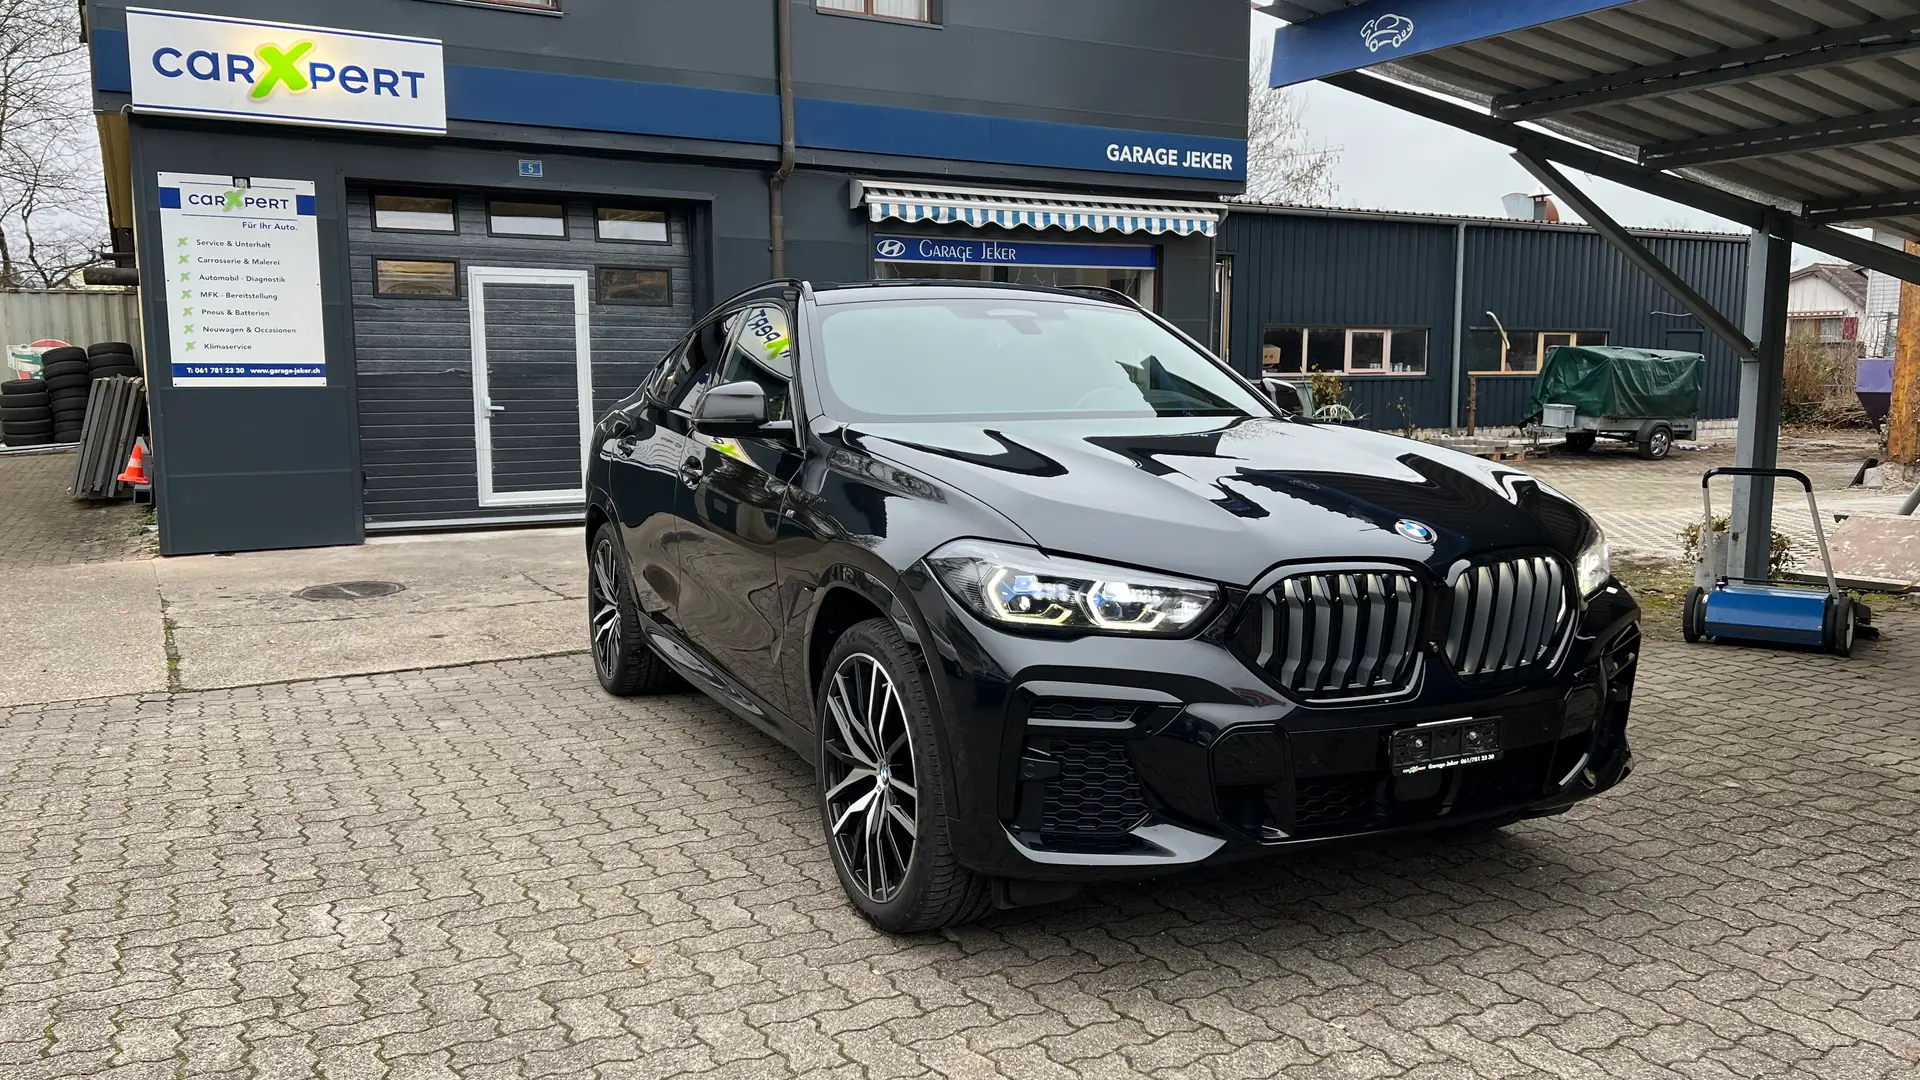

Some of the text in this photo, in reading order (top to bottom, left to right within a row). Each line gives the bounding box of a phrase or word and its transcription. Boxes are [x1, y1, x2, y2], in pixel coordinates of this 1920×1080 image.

[1106, 144, 1233, 171] GARAGE JEKER
[528, 163, 534, 173] 5
[242, 221, 298, 231] Für Ihr Auto.
[196, 239, 224, 247] Service
[235, 240, 271, 249] Unterhalt
[197, 256, 241, 265] Carrosserie
[252, 258, 280, 266] Malerei
[199, 274, 239, 282] Automobil
[246, 275, 286, 283] Diagnostik
[225, 292, 278, 301] Bereitstellung
[201, 308, 225, 316] Pneus
[235, 309, 270, 317] Batterien
[202, 326, 244, 334] Neuwagen
[254, 326, 297, 334] Occasionen
[249, 367, 321, 375] www.garage-jeker.ch
